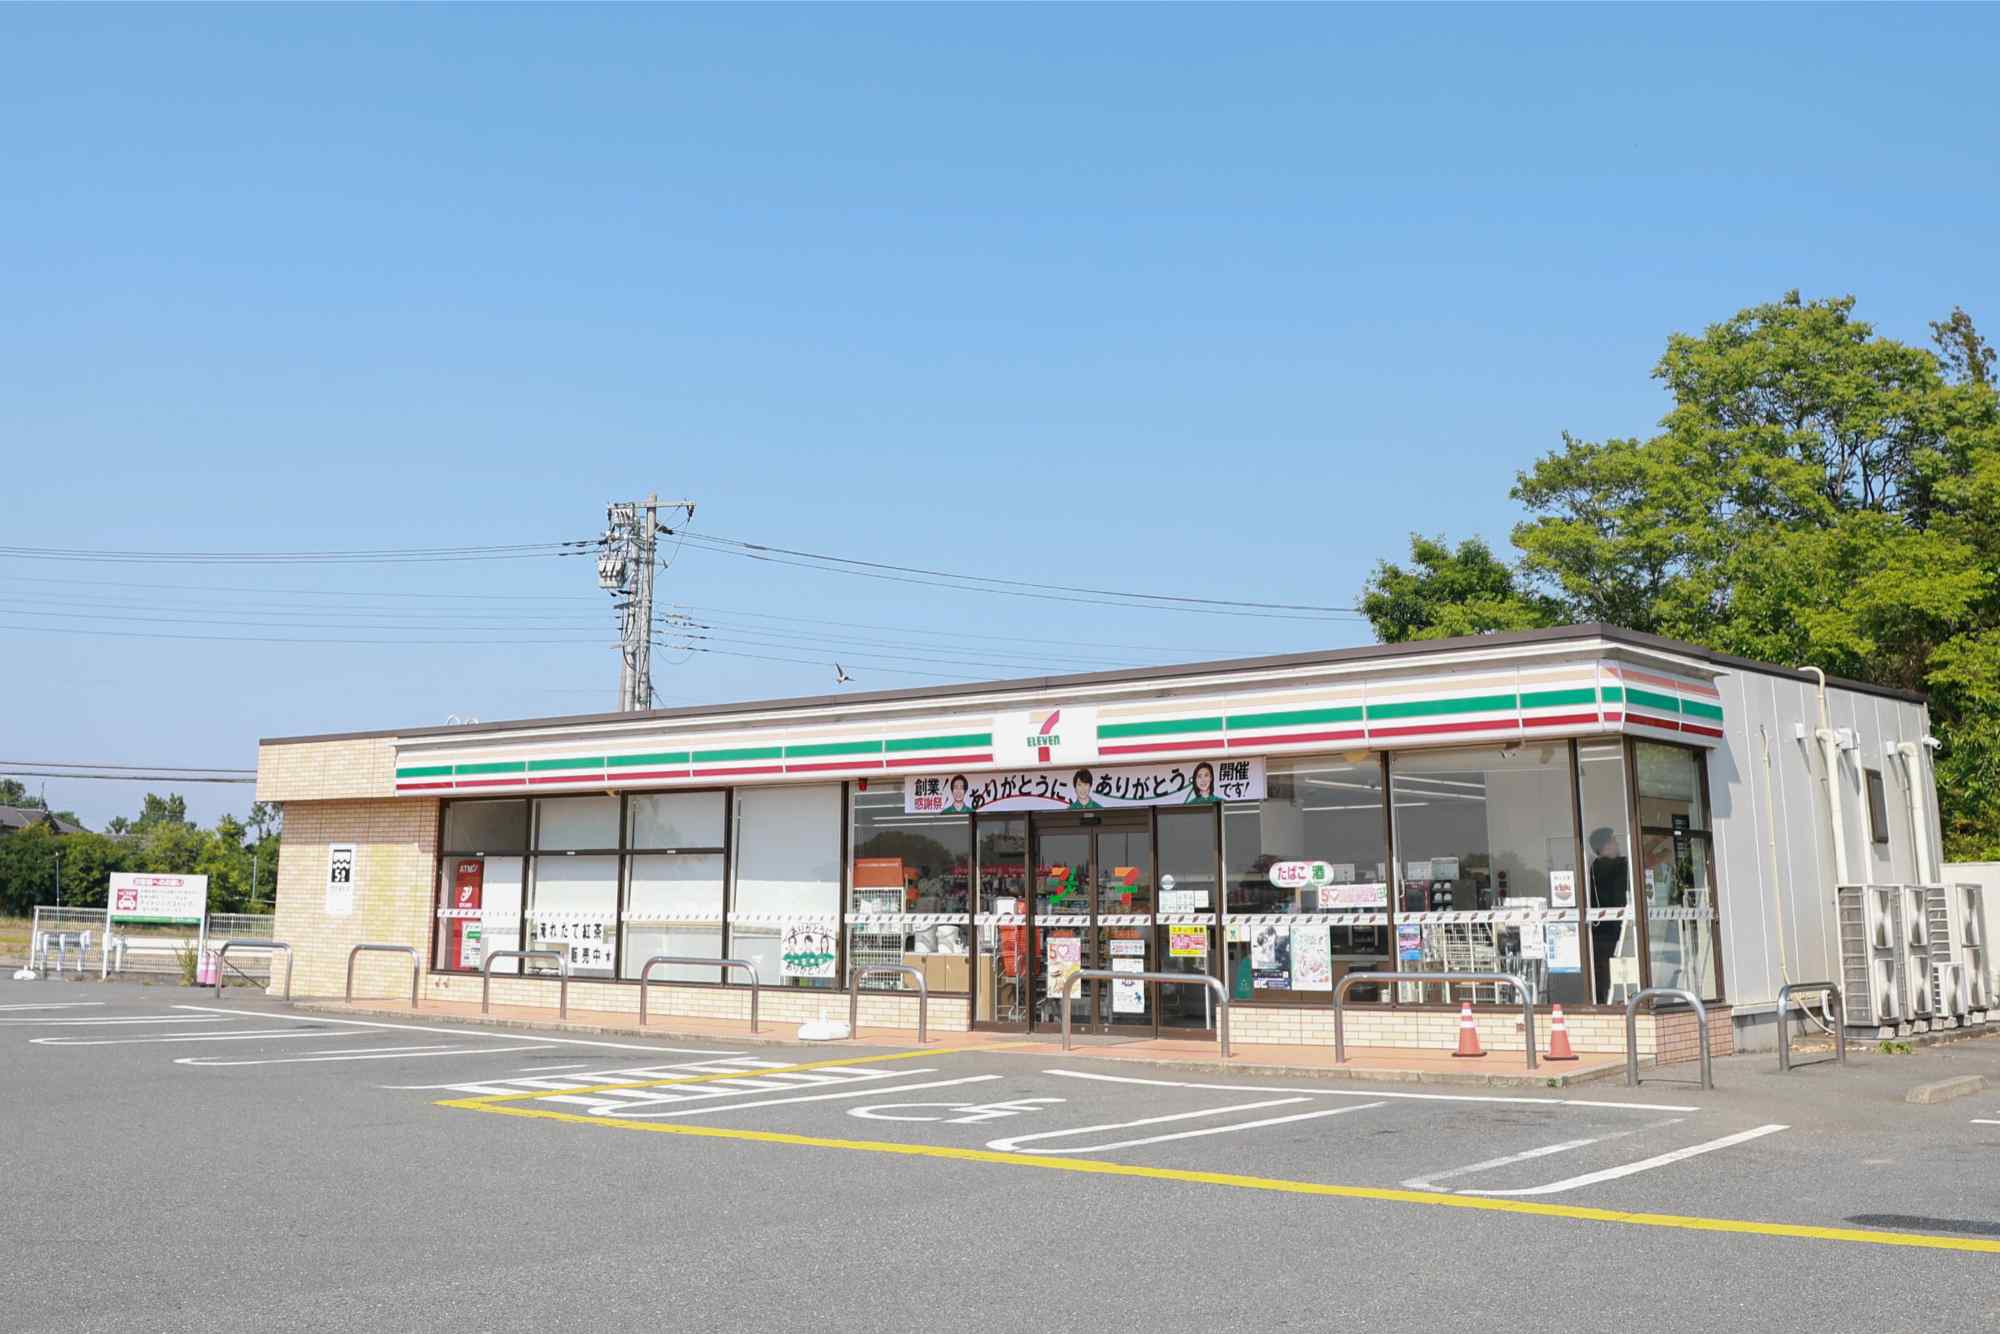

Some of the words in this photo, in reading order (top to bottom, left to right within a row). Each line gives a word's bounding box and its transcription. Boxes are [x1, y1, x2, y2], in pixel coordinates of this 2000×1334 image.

[1218, 762, 1249, 781] 開催
[1095, 768, 1186, 799] ありがとう
[1278, 865, 1307, 880] たばこ
